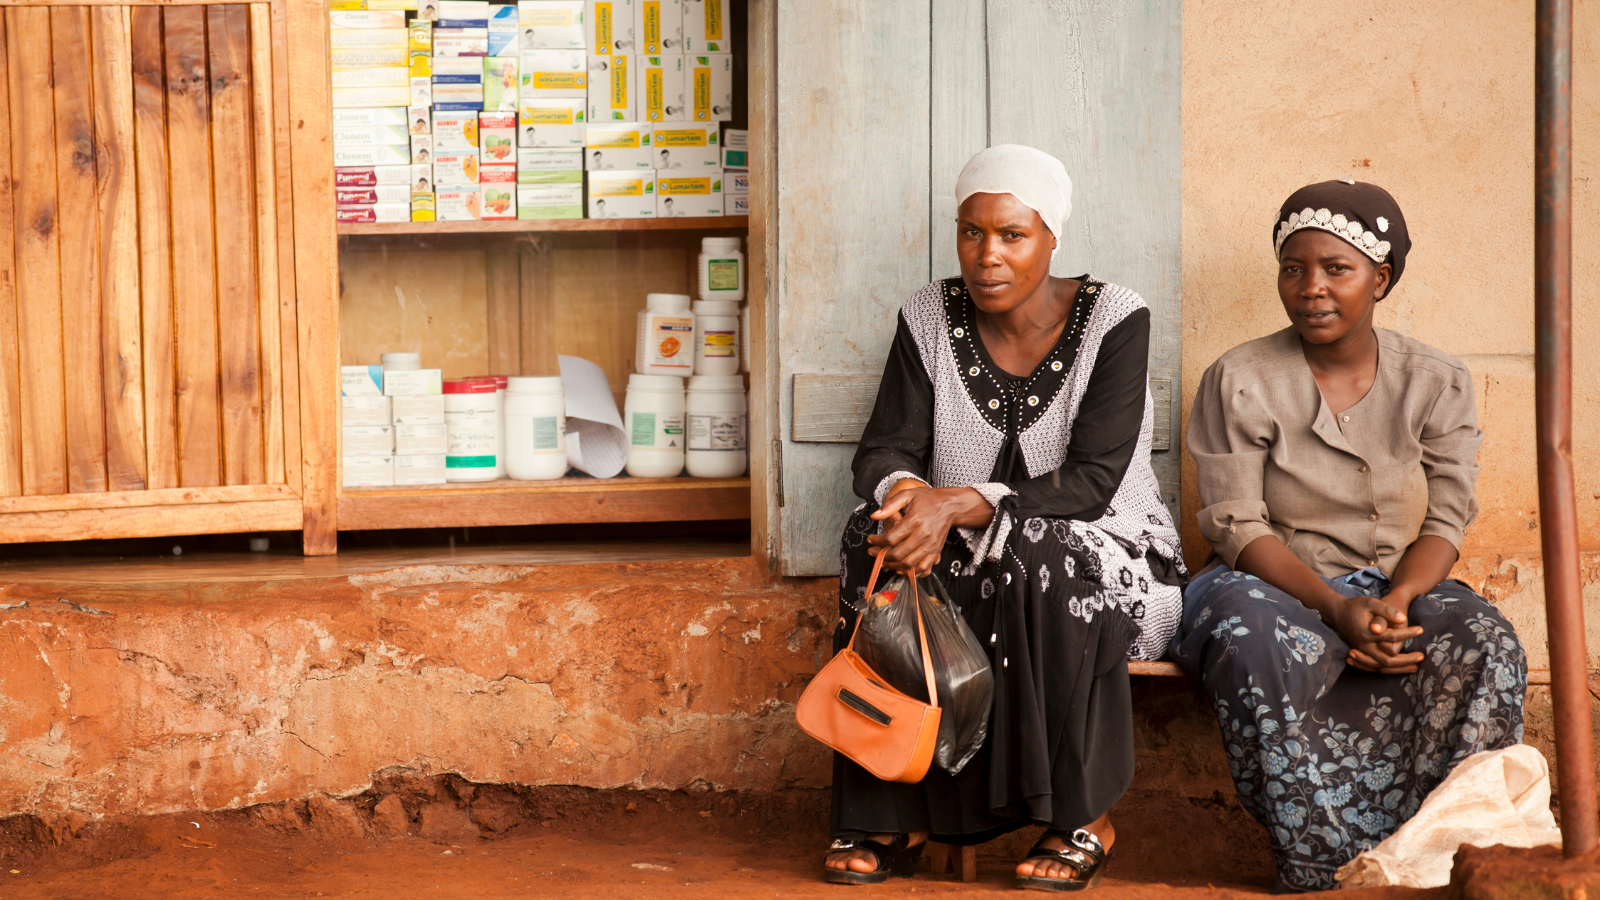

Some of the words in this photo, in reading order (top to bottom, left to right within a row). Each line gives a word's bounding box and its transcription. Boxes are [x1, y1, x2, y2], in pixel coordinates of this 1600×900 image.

[333, 113, 369, 121] Clonem
[334, 132, 370, 140] Clonem
[335, 152, 371, 160] Clonem
